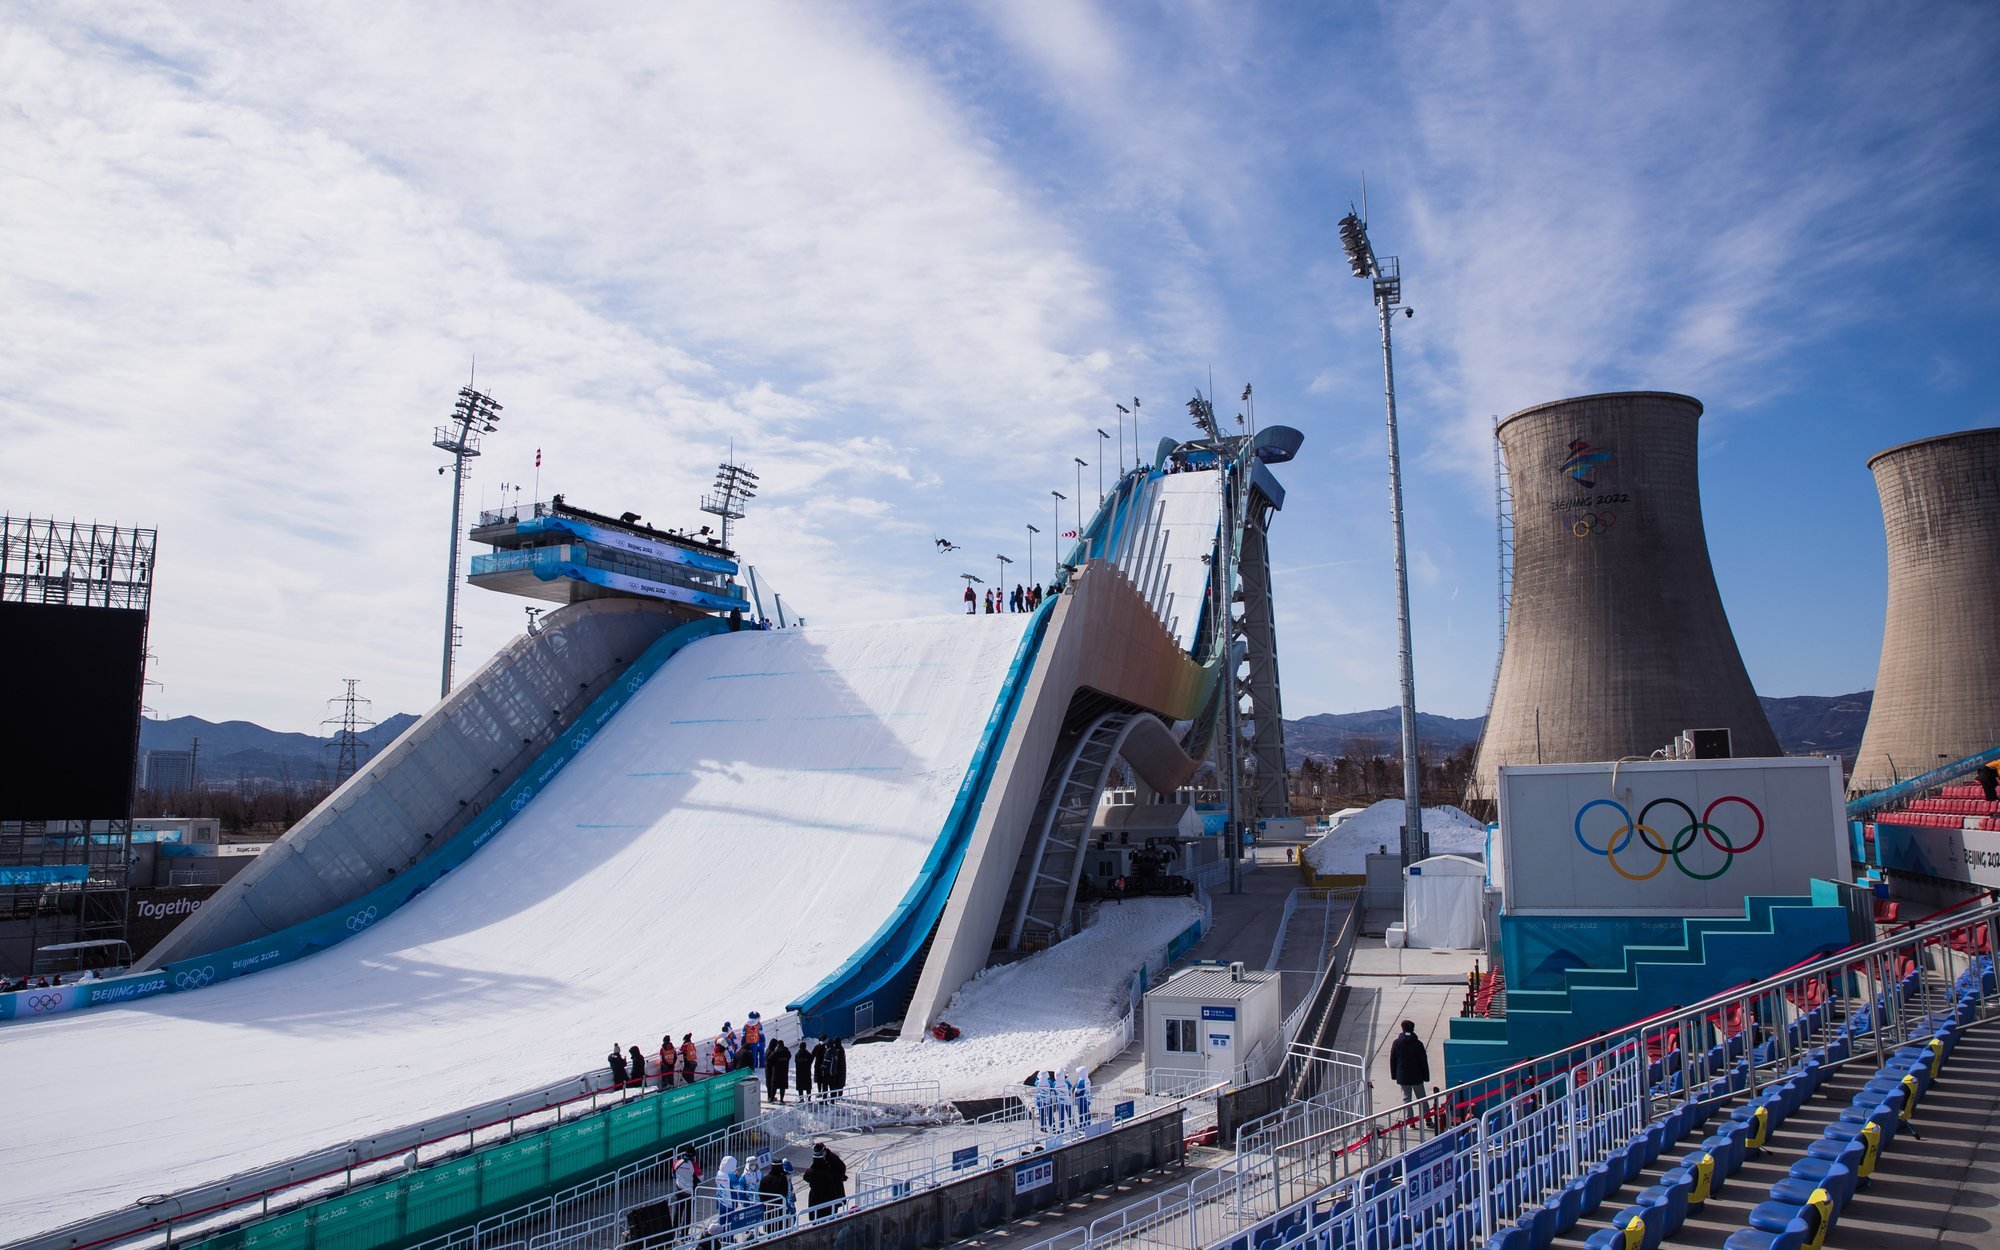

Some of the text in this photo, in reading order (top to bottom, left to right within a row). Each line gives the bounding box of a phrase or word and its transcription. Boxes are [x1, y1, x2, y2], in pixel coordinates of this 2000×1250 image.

[1551, 493, 1630, 512] BEIJING 2022
[492, 552, 544, 569] BEIJING 2022
[1913, 755, 1984, 788] BEIJING 2022
[1963, 848, 1986, 870] BEIJING
[232, 950, 280, 969] BEIJING 2022
[91, 979, 167, 1001] BEIJING 2022
[457, 1159, 492, 1175] BEIJING 2022
[385, 1181, 424, 1200] BEIJING 2022
[303, 1206, 348, 1227] BEIJING 2022
[237, 1236, 258, 1249] 2022
